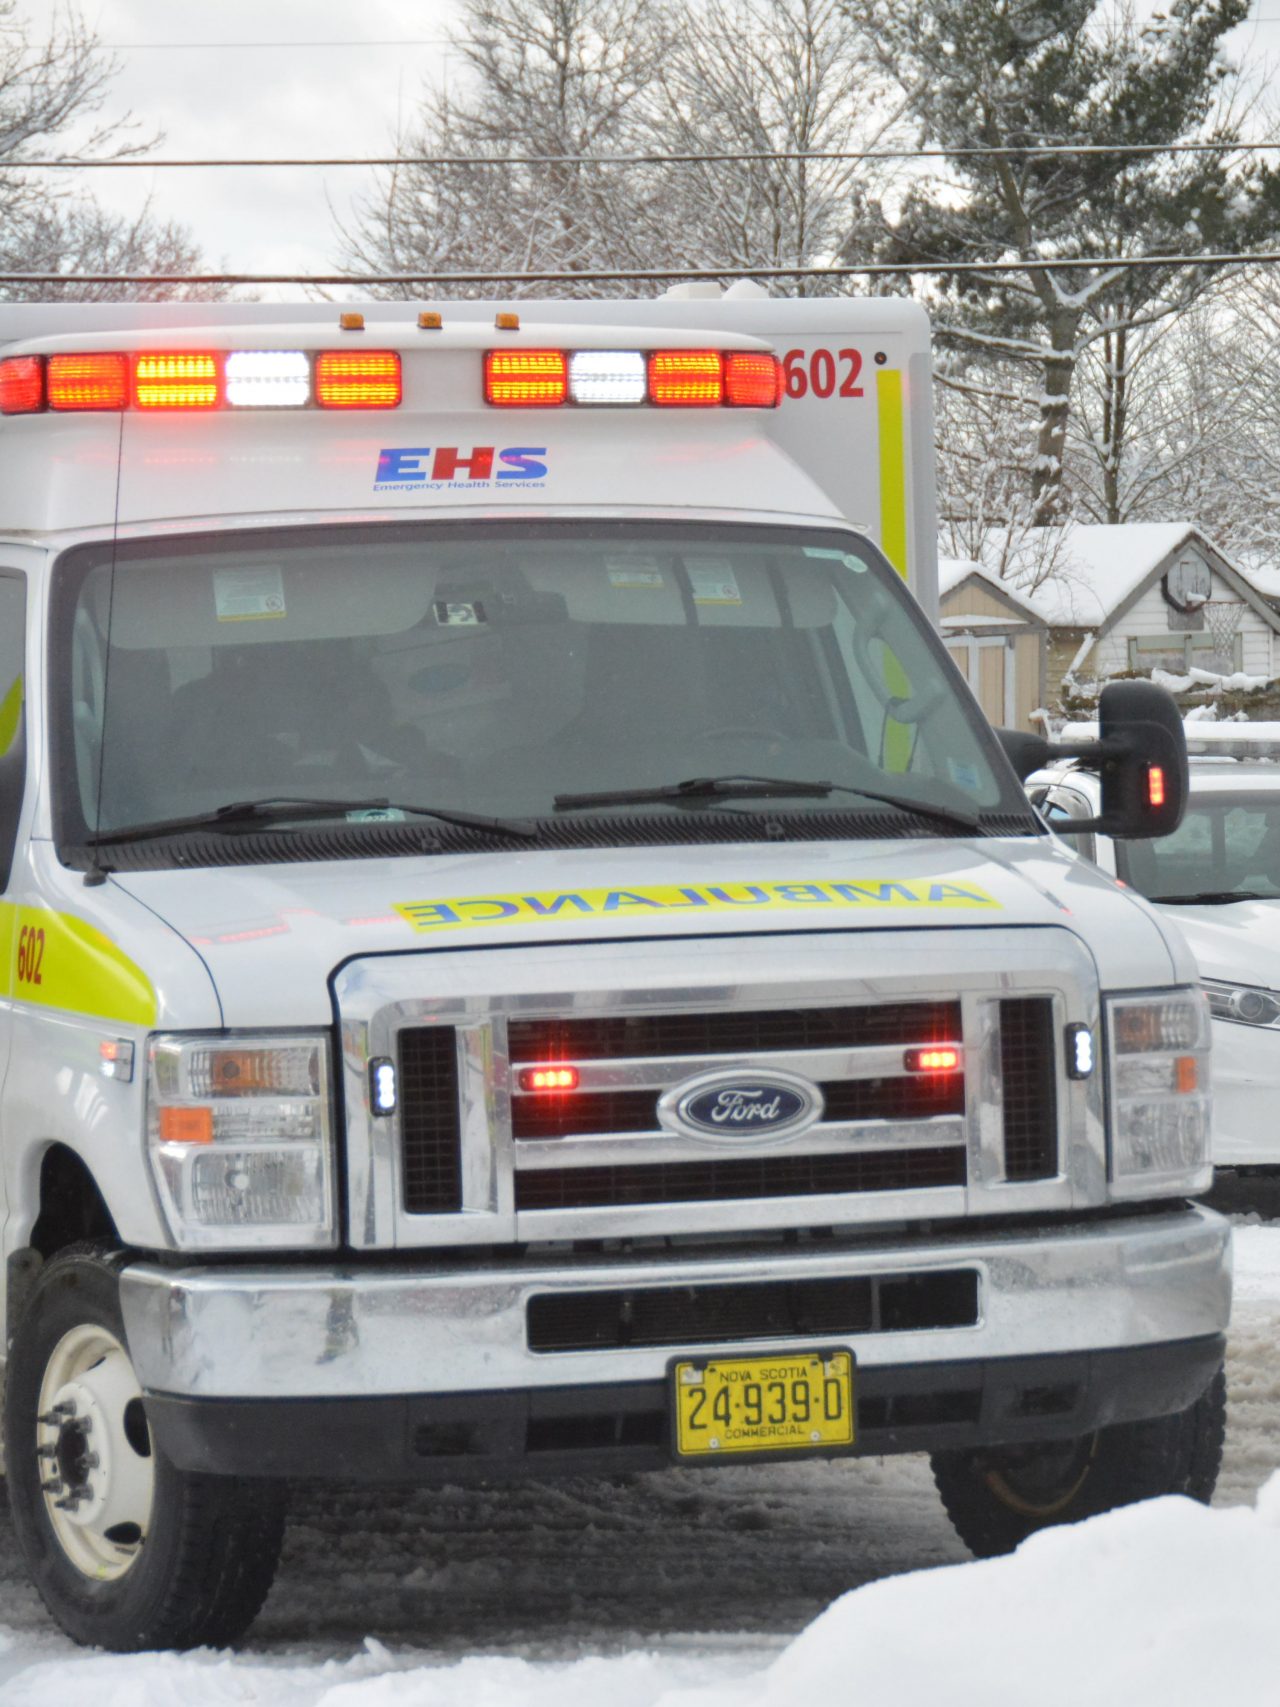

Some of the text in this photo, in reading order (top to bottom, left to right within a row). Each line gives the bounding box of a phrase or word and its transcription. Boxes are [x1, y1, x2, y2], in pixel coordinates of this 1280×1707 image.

[782, 348, 864, 399] 602
[375, 447, 548, 482] EHS
[373, 482, 443, 491] Emergency
[18, 924, 45, 985] 602
[711, 1090, 780, 1122] Ford
[719, 1366, 807, 1382] NOVA SCOTIA
[725, 1426, 805, 1440] COMMERCIAL
